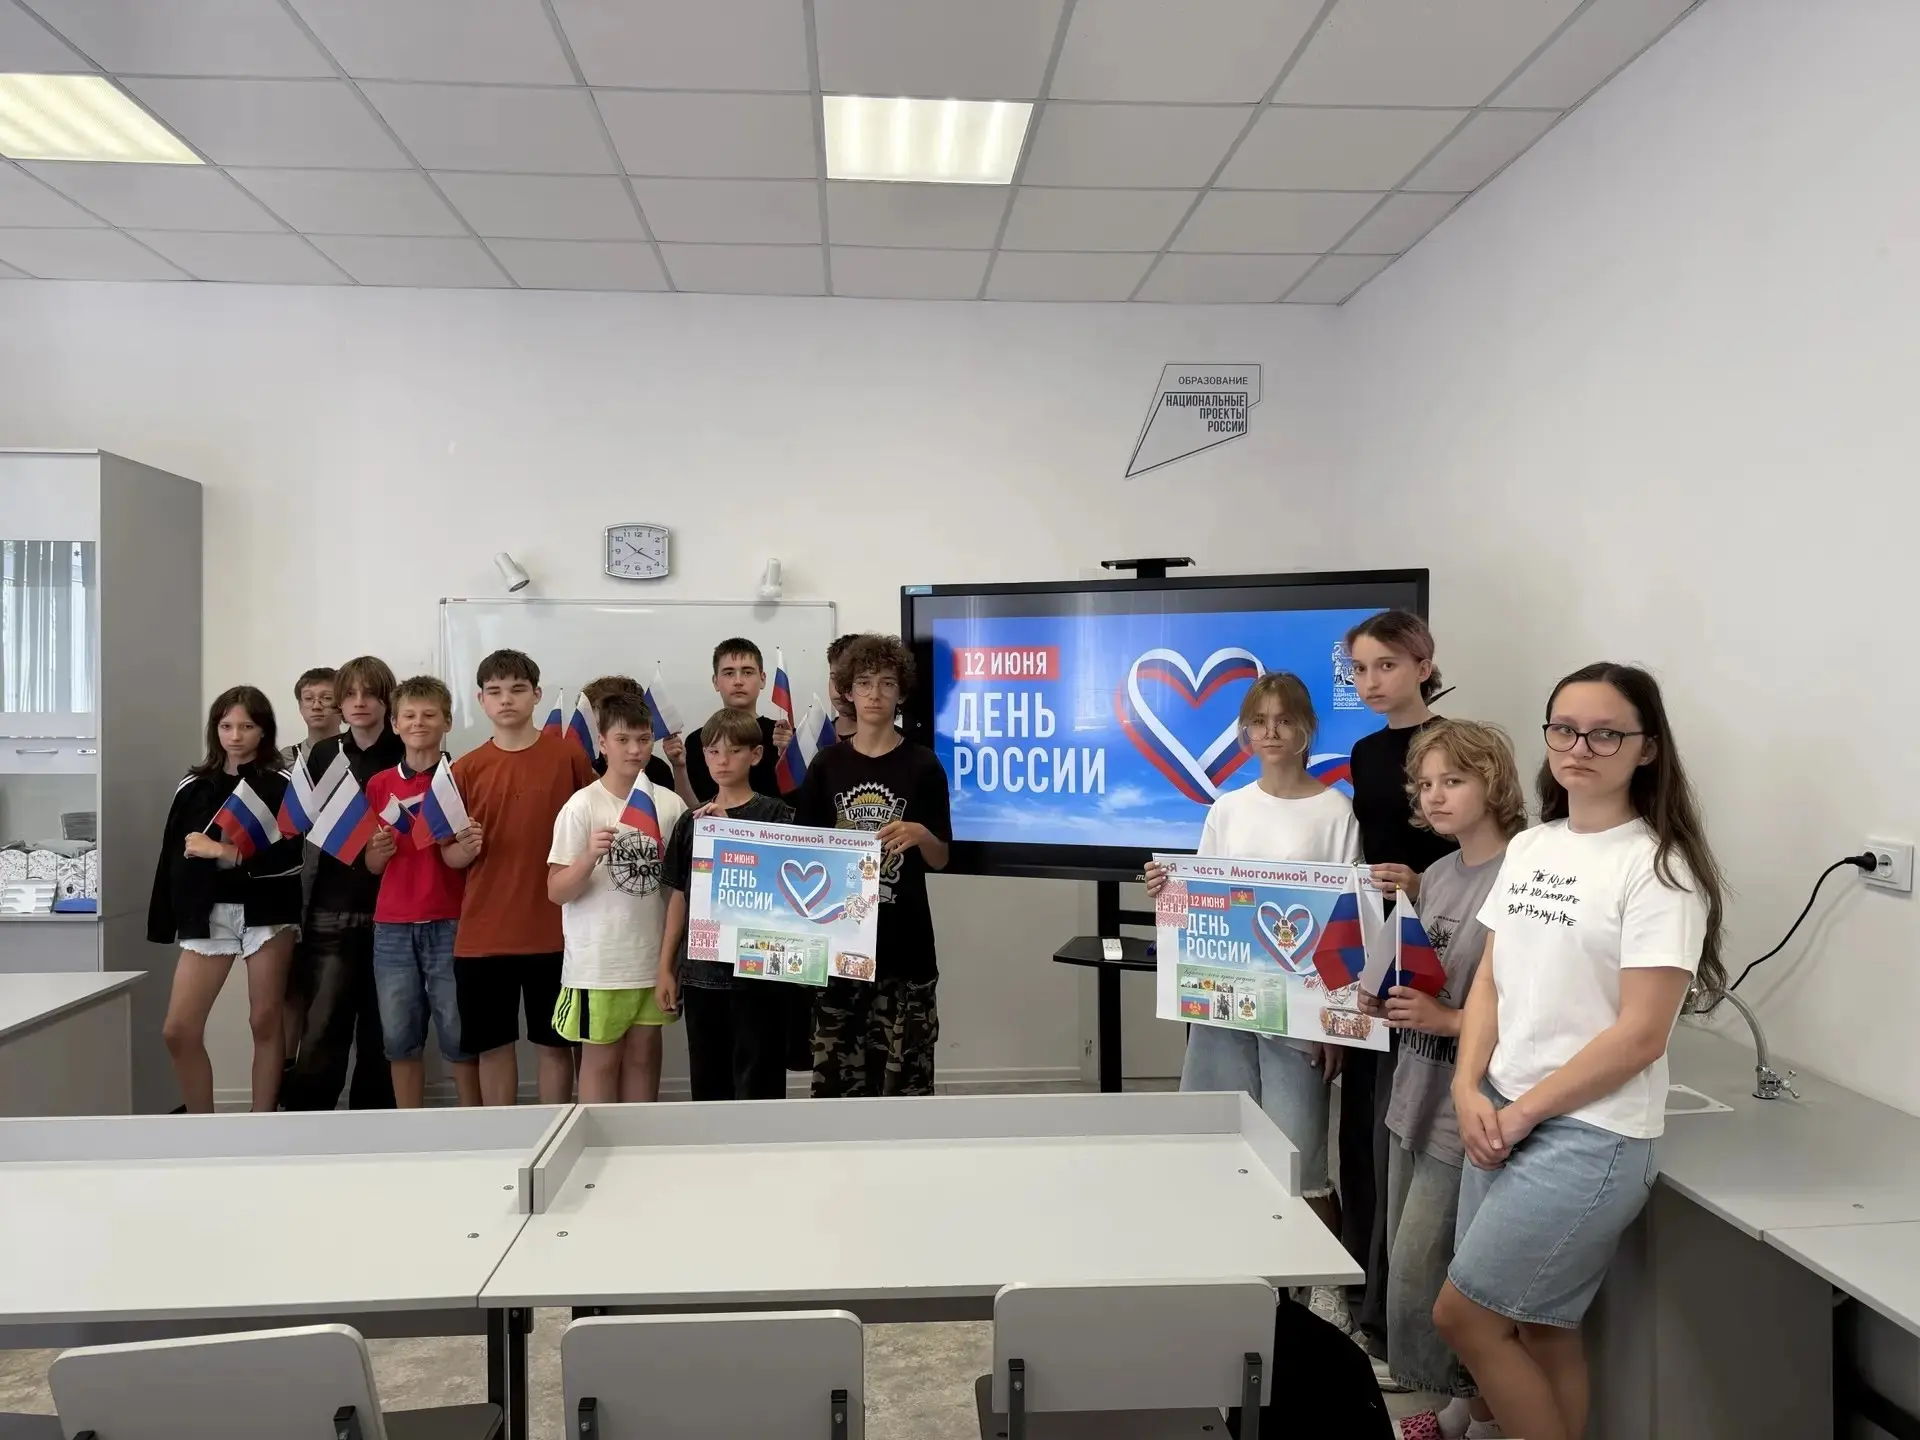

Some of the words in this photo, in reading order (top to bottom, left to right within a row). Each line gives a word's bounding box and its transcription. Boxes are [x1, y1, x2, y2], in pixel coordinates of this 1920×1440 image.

[1178, 376, 1248, 385] ОБРАЗОВАНИЕ
[1166, 395, 1245, 408] НАЦИОНАЛЬНЫЕ
[1200, 408, 1245, 419] ПРОЕКТЫ
[1207, 421, 1245, 432] РОССИИ
[964, 652, 985, 676] 12
[991, 651, 1047, 676] ИЮНЯ
[954, 692, 1056, 744] ДЕНЬ
[953, 746, 1106, 795] РОССИИ
[848, 808, 876, 820] BRING
[876, 809, 891, 820] ME
[728, 828, 755, 838] часть
[760, 829, 824, 844] Многоликой
[829, 835, 875, 847] России»
[724, 853, 733, 863] 12
[734, 853, 755, 865] ИЮНЯ
[718, 868, 757, 889] ДЕНЬ
[1193, 866, 1225, 876] часть
[1231, 866, 1308, 882] Многоликой
[1314, 871, 1372, 885] Росс»
[718, 888, 773, 911] РОССИИ
[1190, 895, 1200, 907] 12
[1201, 896, 1225, 909] ИЮНЯ
[1186, 913, 1230, 937] ДЕНЬ
[1186, 936, 1251, 964] РОССИИ
